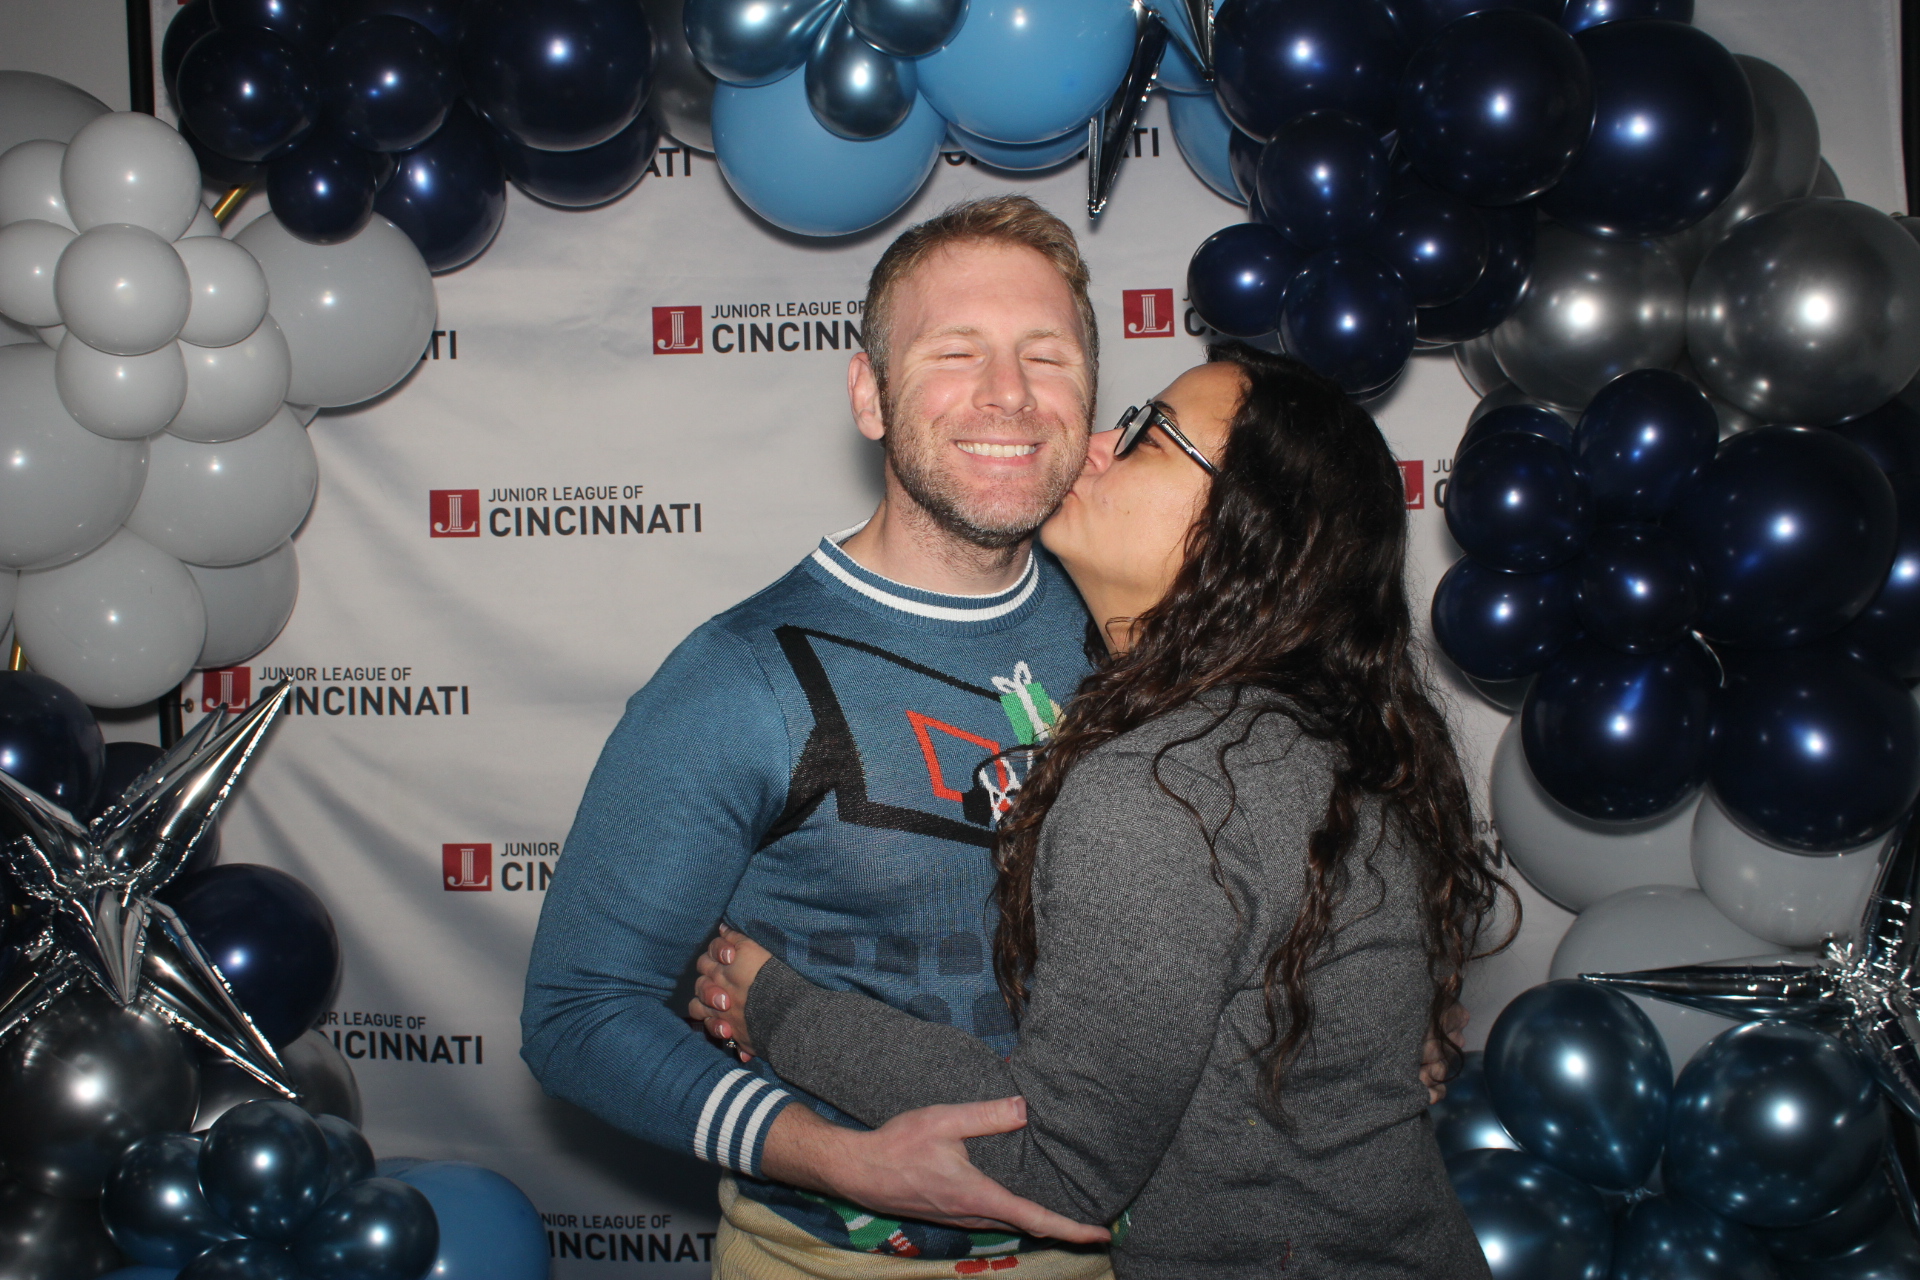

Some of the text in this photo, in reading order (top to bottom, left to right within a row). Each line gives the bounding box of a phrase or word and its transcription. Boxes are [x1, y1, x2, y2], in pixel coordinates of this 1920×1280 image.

[1123, 127, 1160, 158] TI
[711, 300, 866, 319] JUNIOR LEAGUE OF
[420, 330, 457, 360] TI
[488, 485, 644, 503] JUNIOR LEAGUE OF
[489, 503, 702, 537] CINCINNATI
[258, 667, 412, 681] JUNIOR LEAGUE OF
[500, 842, 560, 857] JUNIOR
[343, 1012, 403, 1029] LEAGUE
[406, 1016, 427, 1030] OF
[582, 1215, 646, 1229] LEAGUE
[650, 1215, 672, 1229] OF
